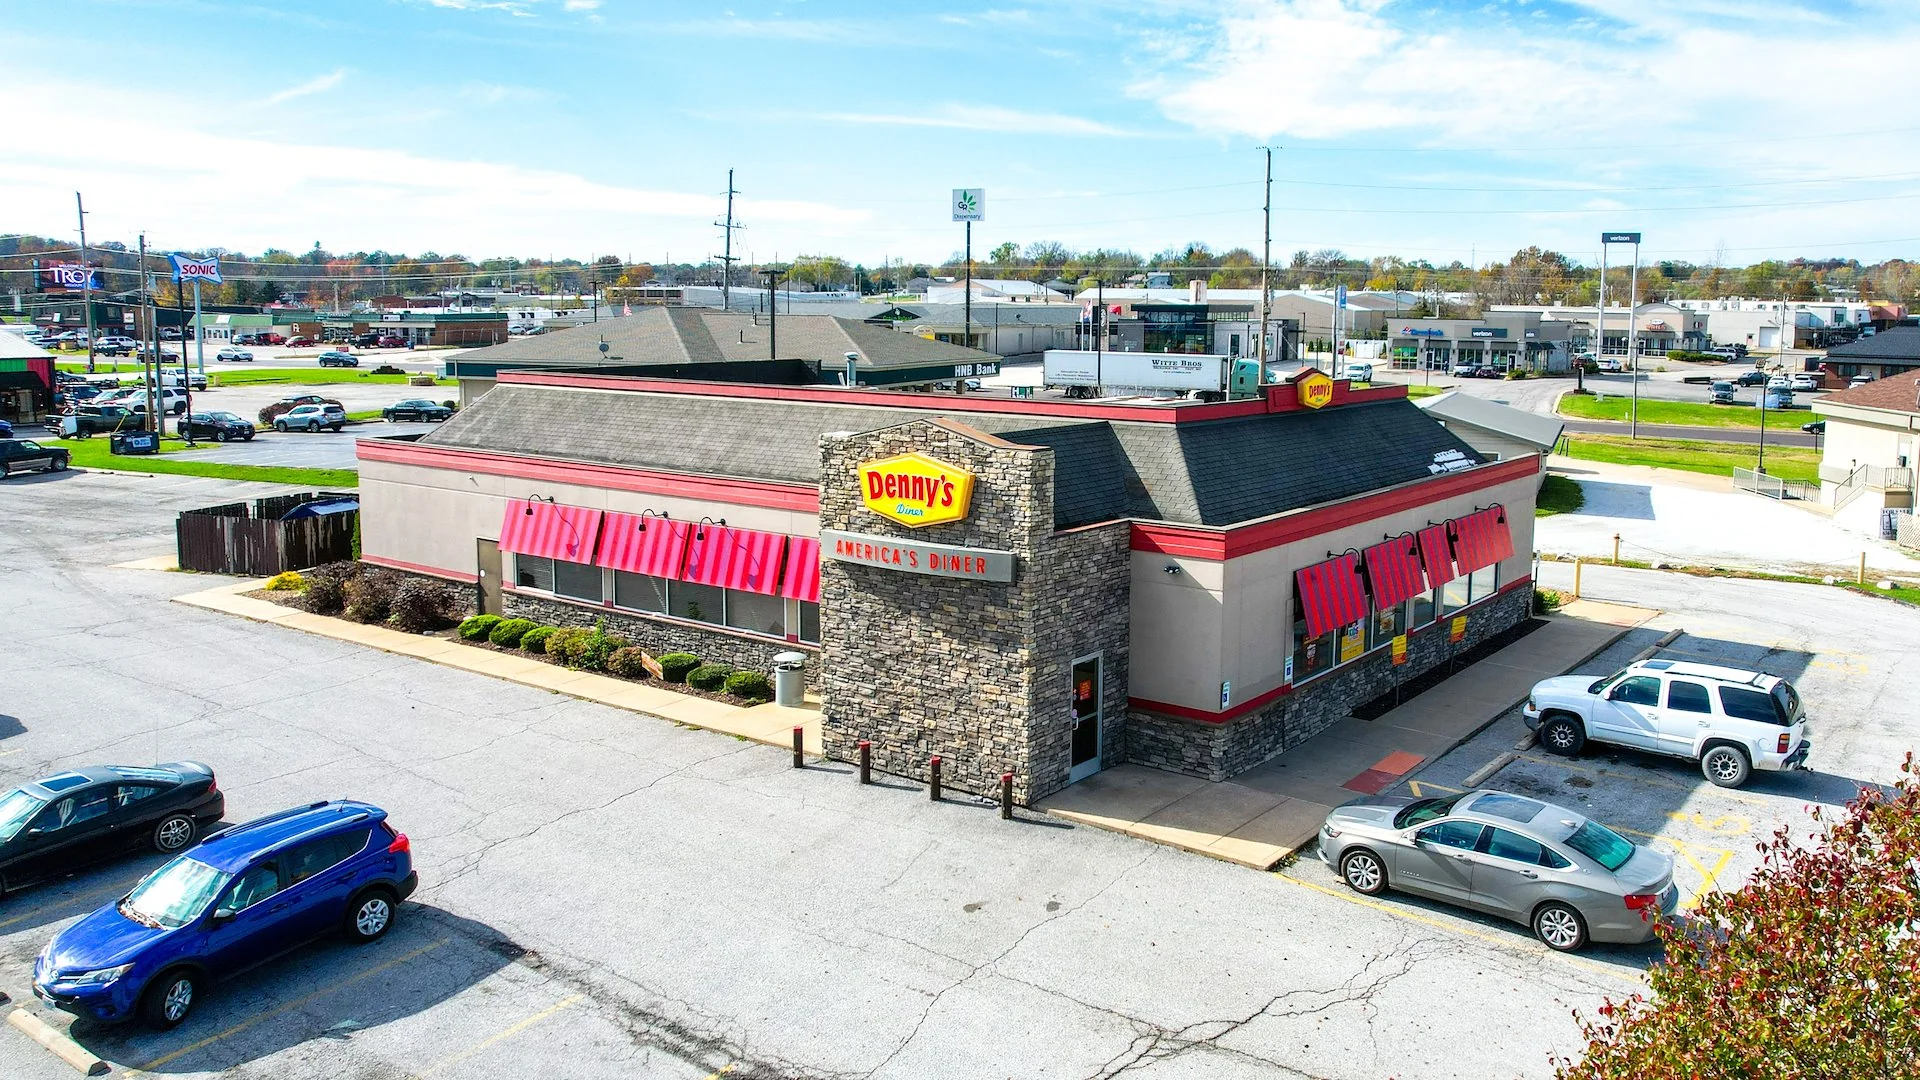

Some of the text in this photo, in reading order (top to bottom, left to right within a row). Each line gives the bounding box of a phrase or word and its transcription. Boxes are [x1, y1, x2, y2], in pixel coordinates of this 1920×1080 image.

[50, 267, 96, 284] TROY
[181, 264, 216, 275] SONIC
[954, 362, 997, 377] HNB Bank
[1309, 382, 1331, 399] Denny's
[867, 471, 954, 507] Denny's
[895, 503, 924, 517] Diner
[835, 539, 986, 574] AMERICA'S DINER
